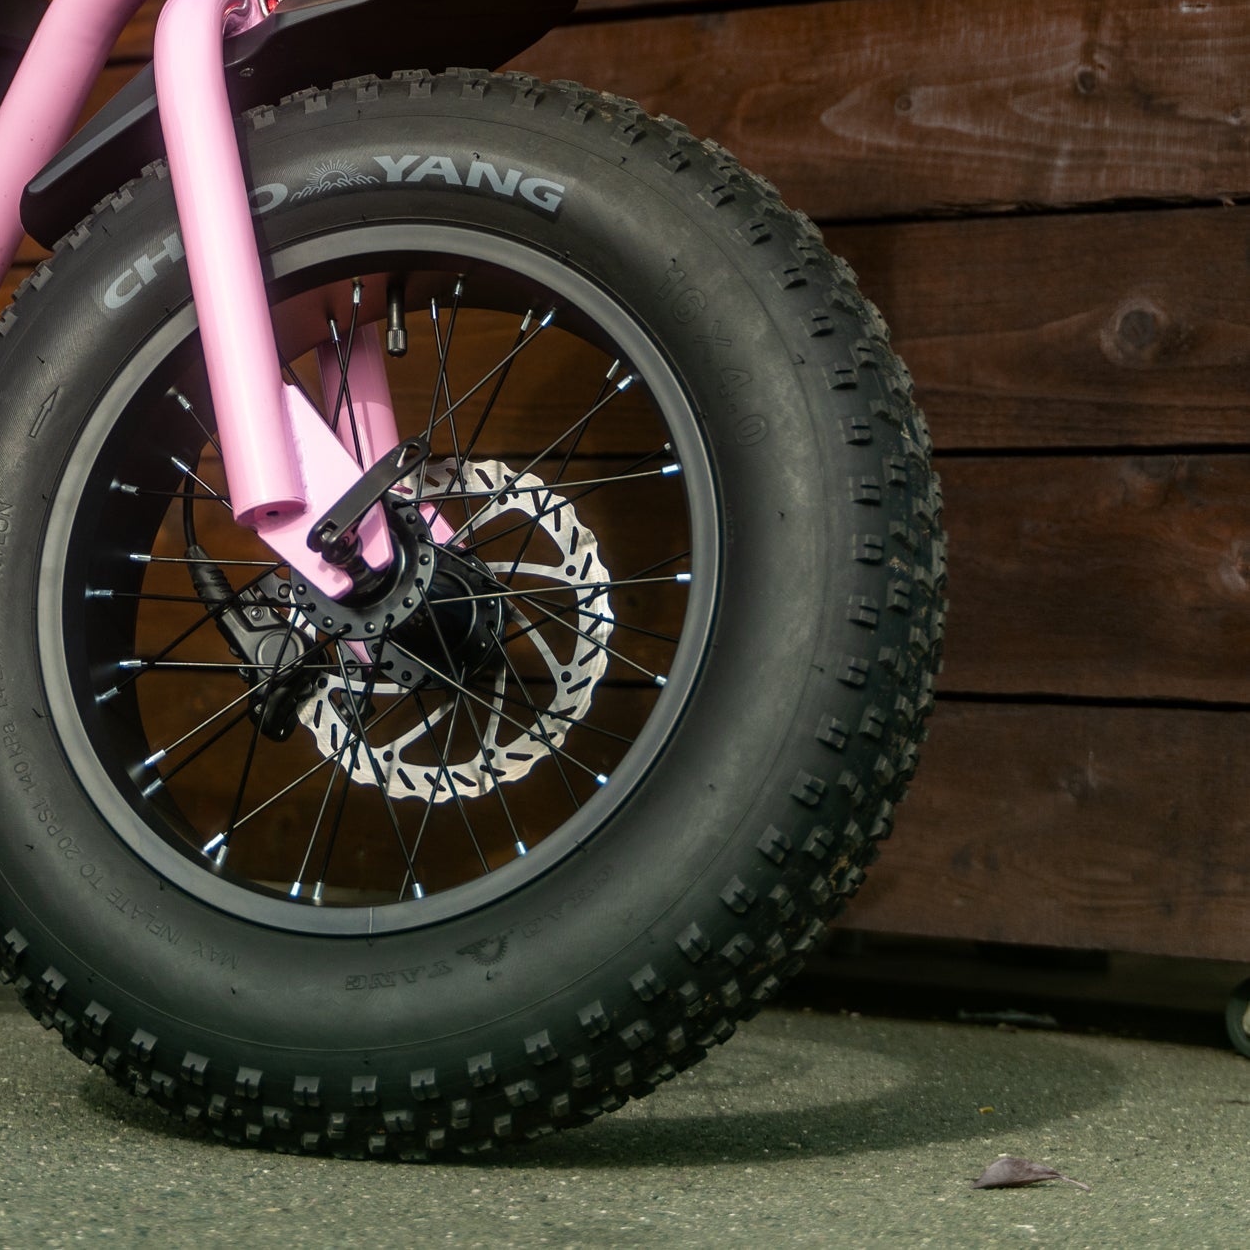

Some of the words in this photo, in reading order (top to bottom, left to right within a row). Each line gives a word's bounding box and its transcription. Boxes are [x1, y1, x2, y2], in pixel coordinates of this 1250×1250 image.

[103, 183, 288, 310] CHO
[372, 154, 565, 213] YANG
[11, 758, 40, 794] 140
[55, 833, 82, 862] 20
[76, 859, 107, 891] TO
[104, 888, 182, 946] INFLATE
